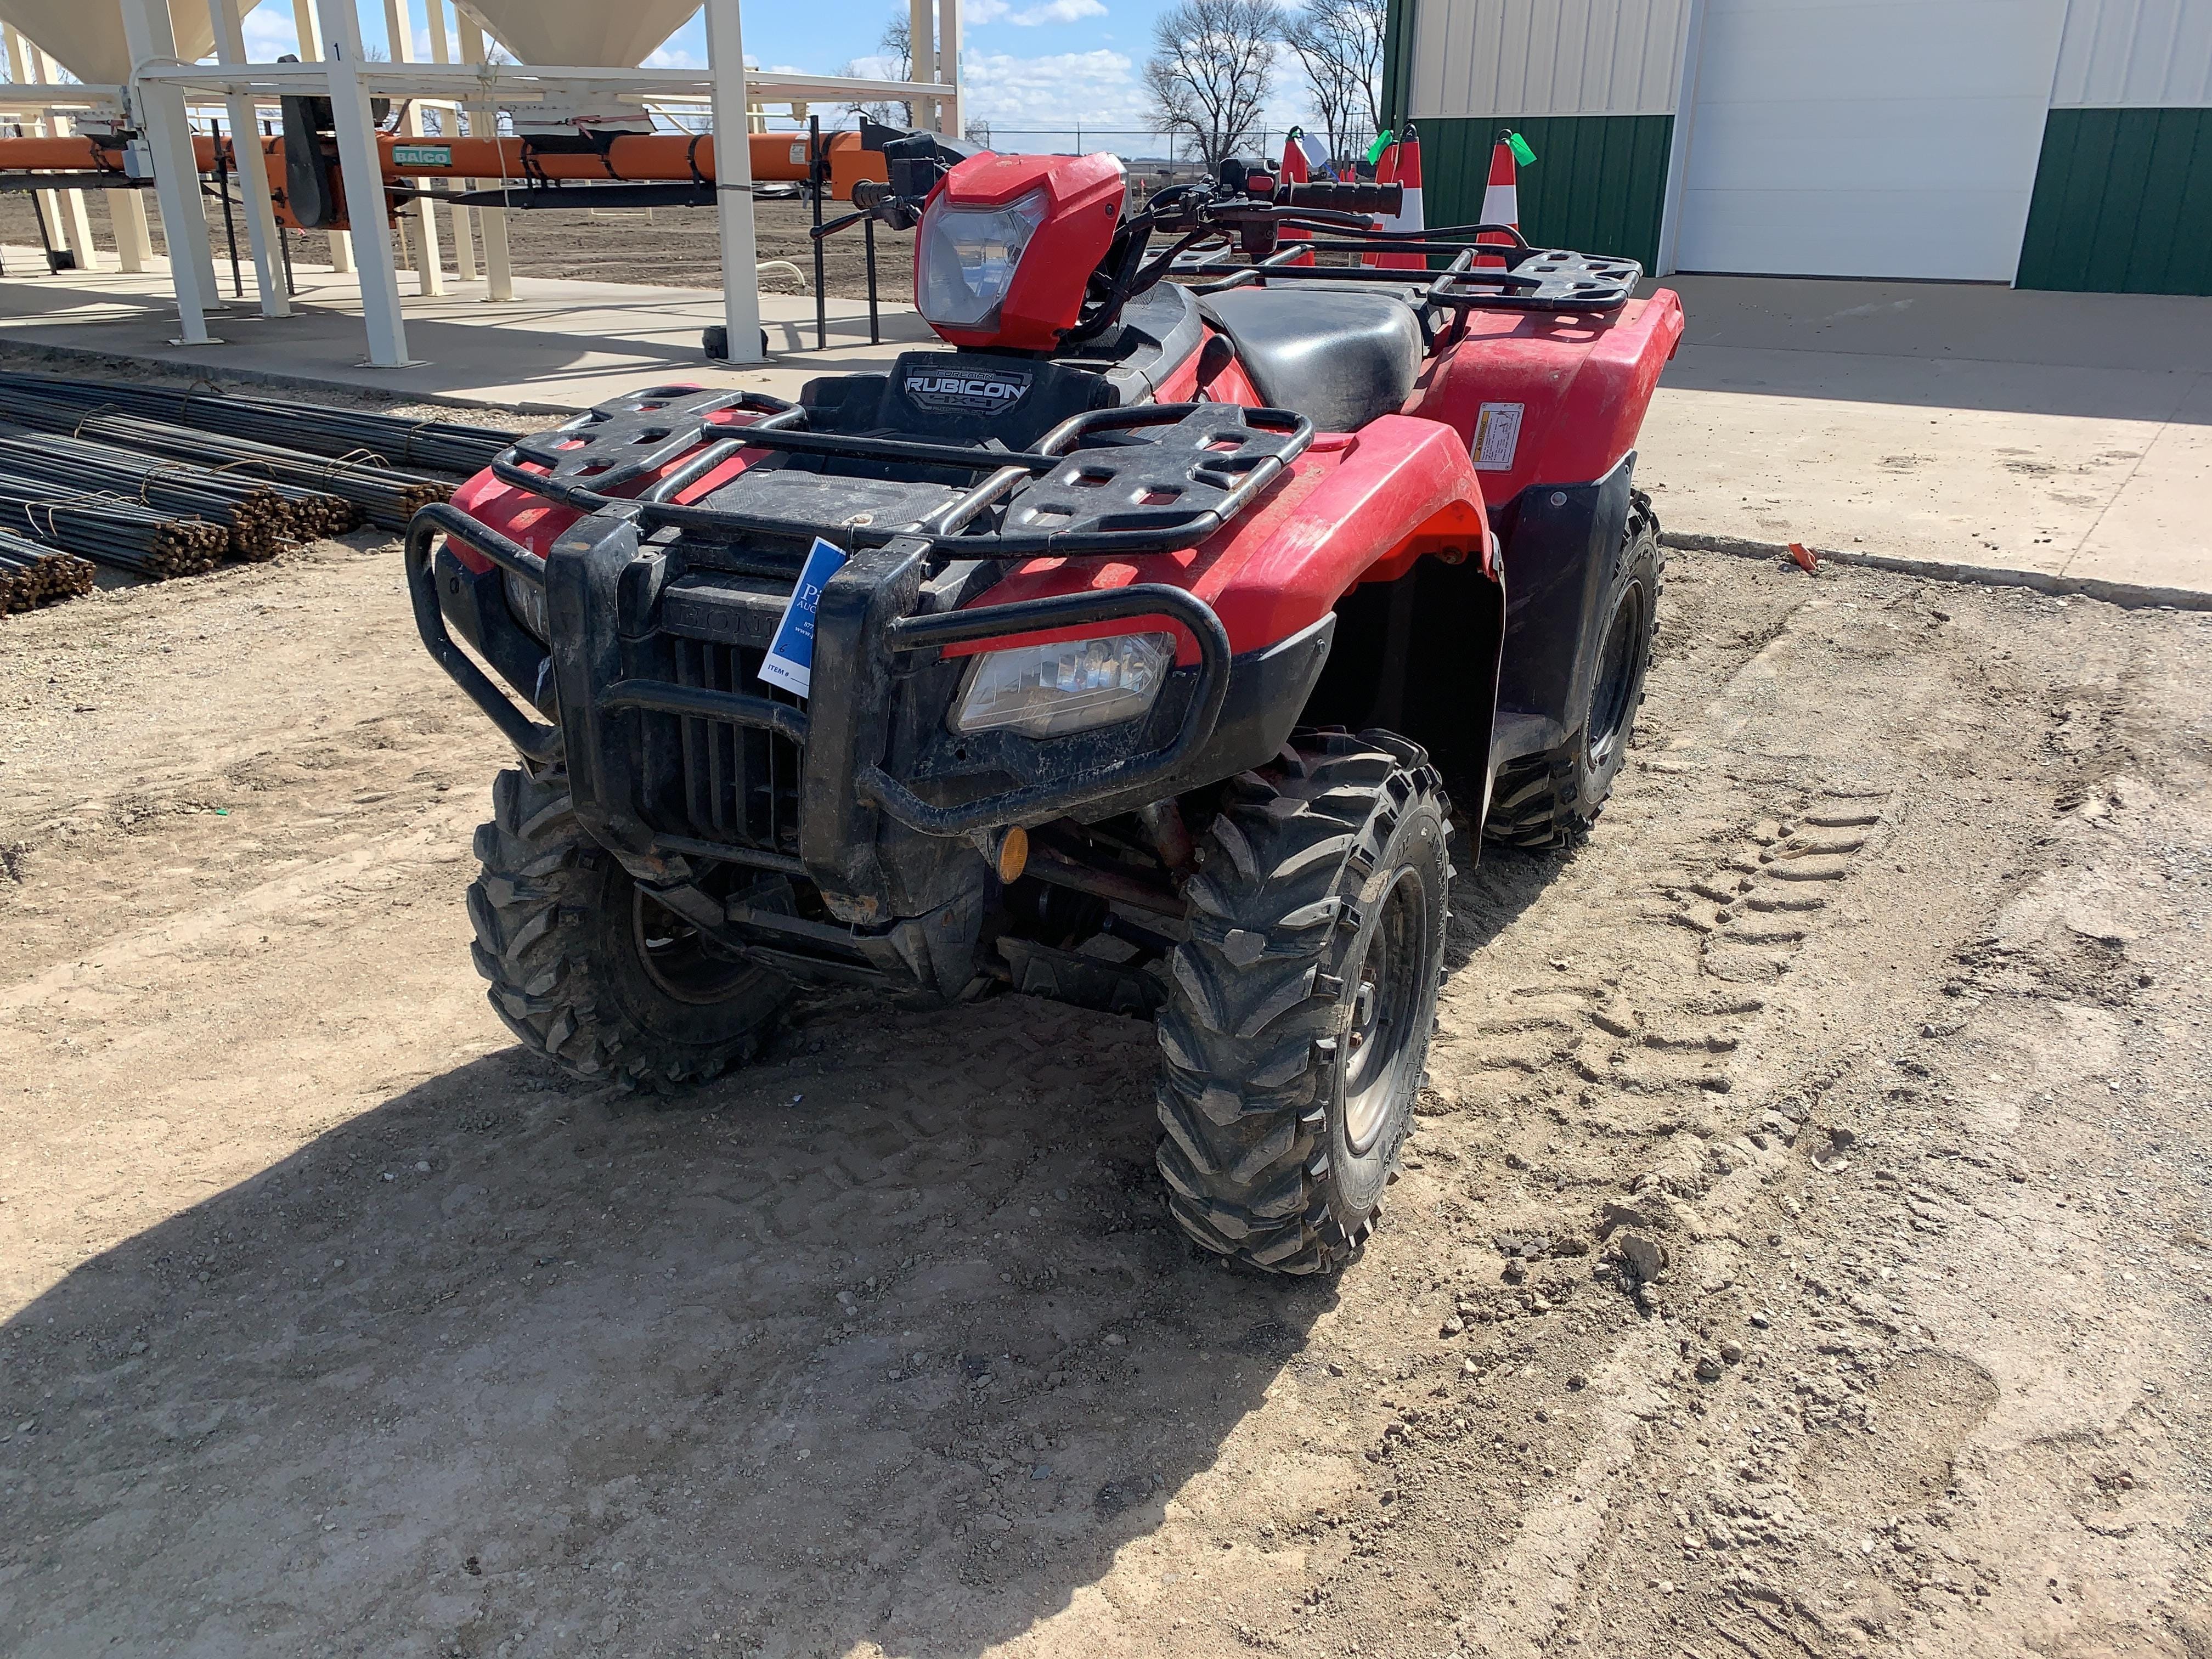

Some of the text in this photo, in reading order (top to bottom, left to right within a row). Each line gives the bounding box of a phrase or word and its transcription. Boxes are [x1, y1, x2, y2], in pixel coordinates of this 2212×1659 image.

[334, 43, 340, 61] 1
[936, 370, 994, 380] FOREMAN
[907, 377, 1026, 400] RUBICON
[1478, 421, 1487, 445] WARNING
[768, 664, 785, 675] ITEM
